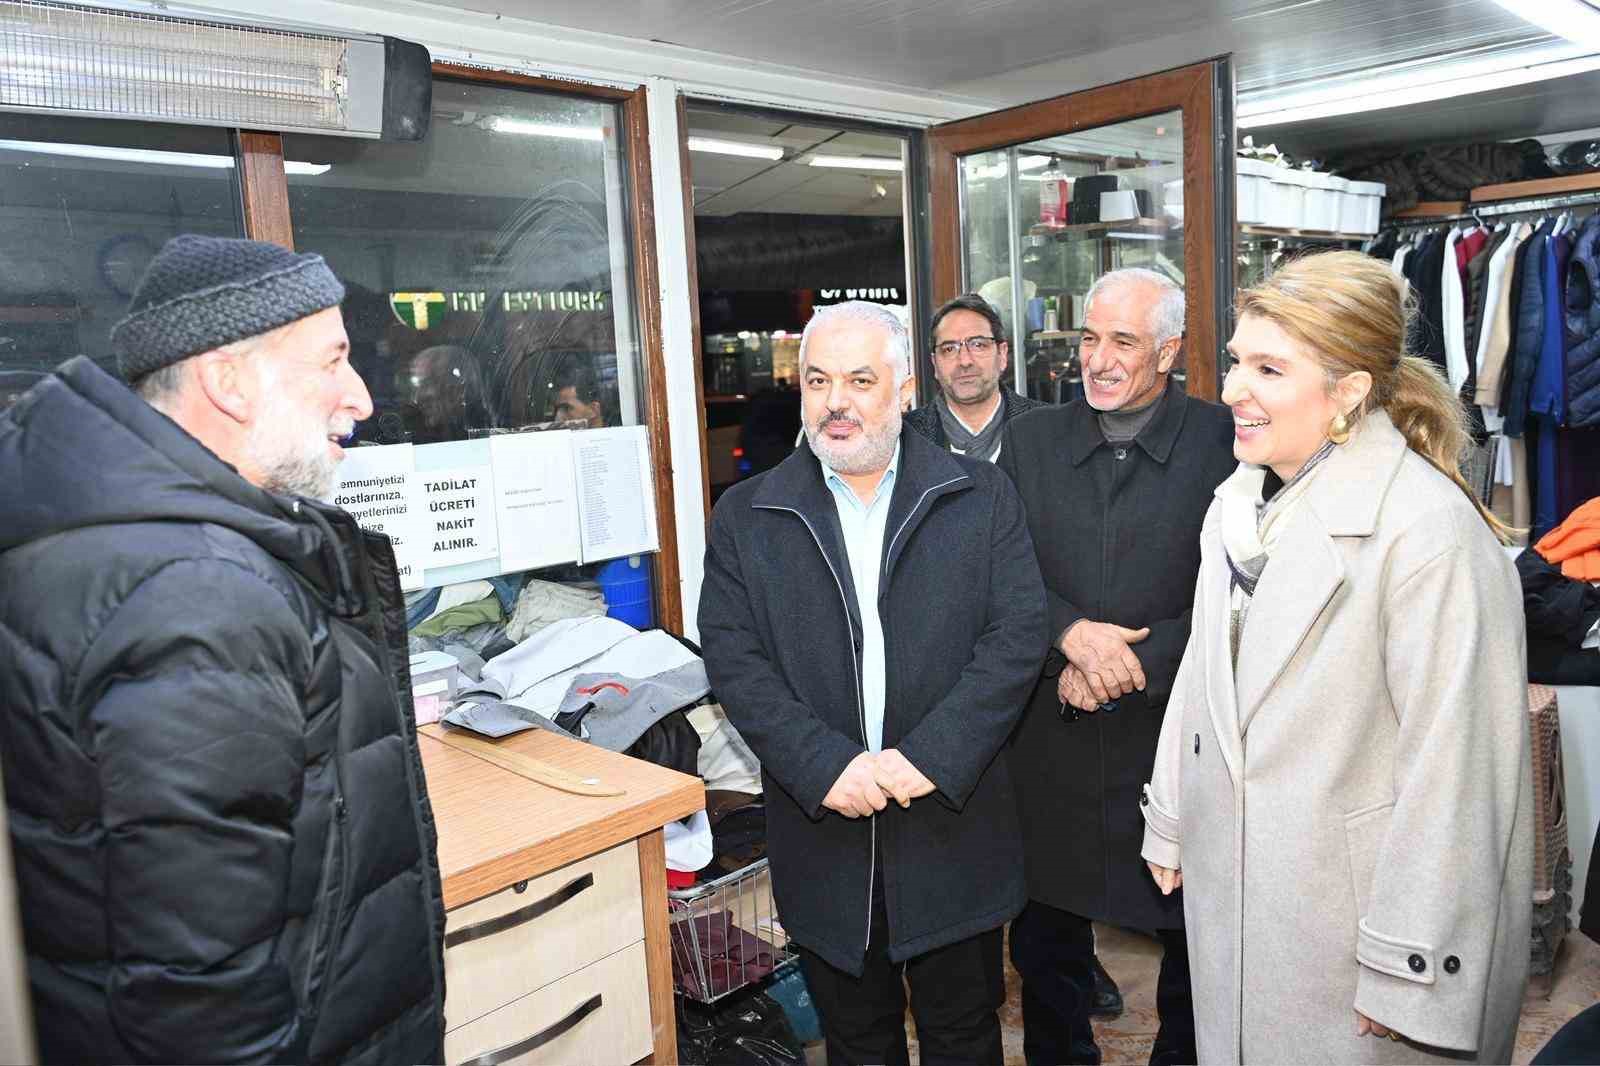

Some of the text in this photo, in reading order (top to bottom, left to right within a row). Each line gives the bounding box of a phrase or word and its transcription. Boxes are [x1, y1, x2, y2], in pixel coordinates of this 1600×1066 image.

[340, 474, 405, 489] emnuniyetizi
[424, 479, 477, 493] TADİLAT
[334, 487, 404, 505] dostlarınıza,
[430, 496, 475, 512] ÜCRETİ
[351, 504, 407, 521] ayetlerinizi
[437, 516, 475, 531] NAKİT
[433, 537, 478, 552] ALINIR.
